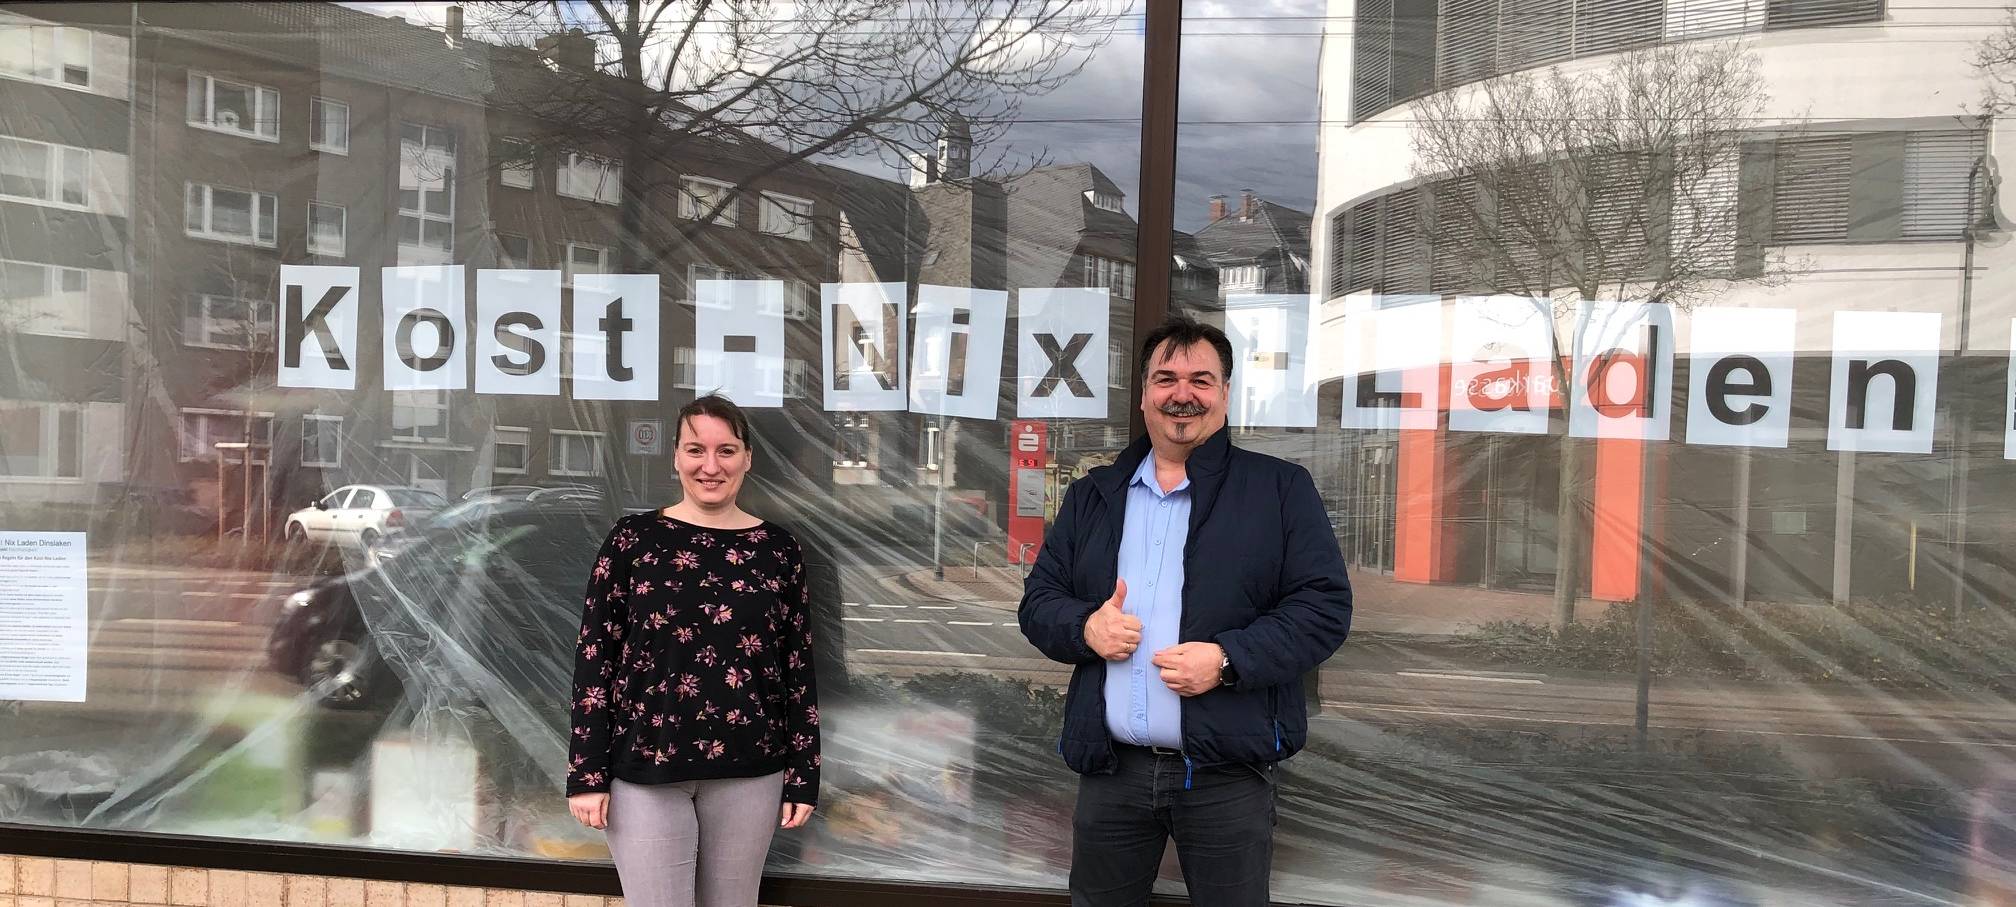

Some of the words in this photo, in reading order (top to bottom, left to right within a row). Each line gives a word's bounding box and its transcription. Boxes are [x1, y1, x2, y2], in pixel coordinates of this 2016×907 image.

[284, 285, 635, 382] Kost
[832, 302, 1096, 399] Nix
[1355, 324, 1918, 432] Laden
